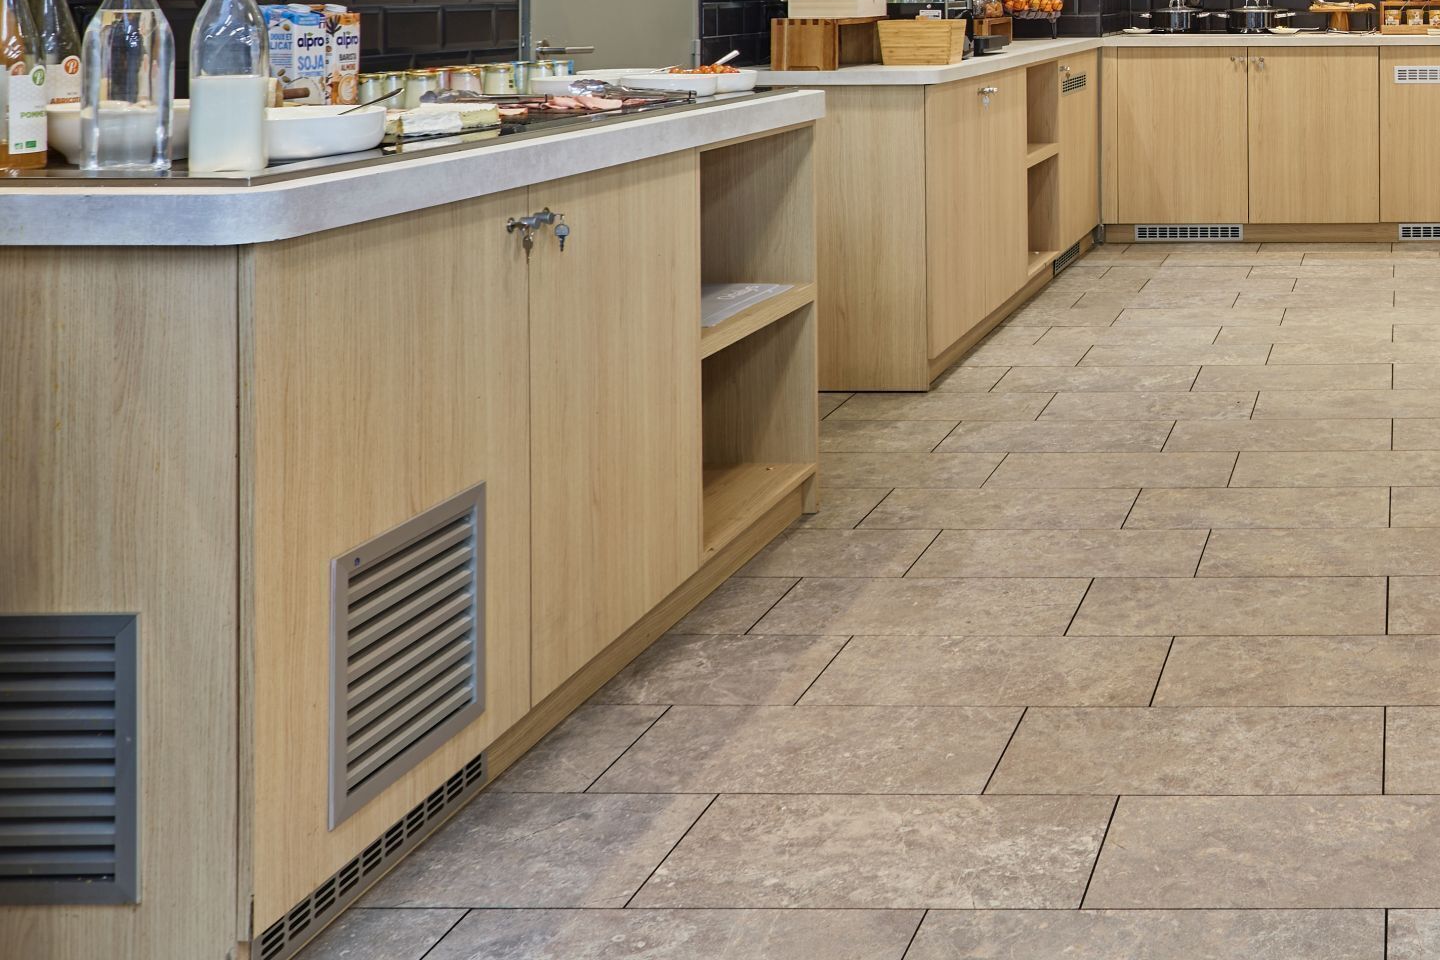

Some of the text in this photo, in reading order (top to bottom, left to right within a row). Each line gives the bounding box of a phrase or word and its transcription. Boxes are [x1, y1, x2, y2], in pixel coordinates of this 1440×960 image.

[297, 32, 325, 51] alpro
[336, 31, 359, 49] alpro
[297, 54, 325, 71] SOJA
